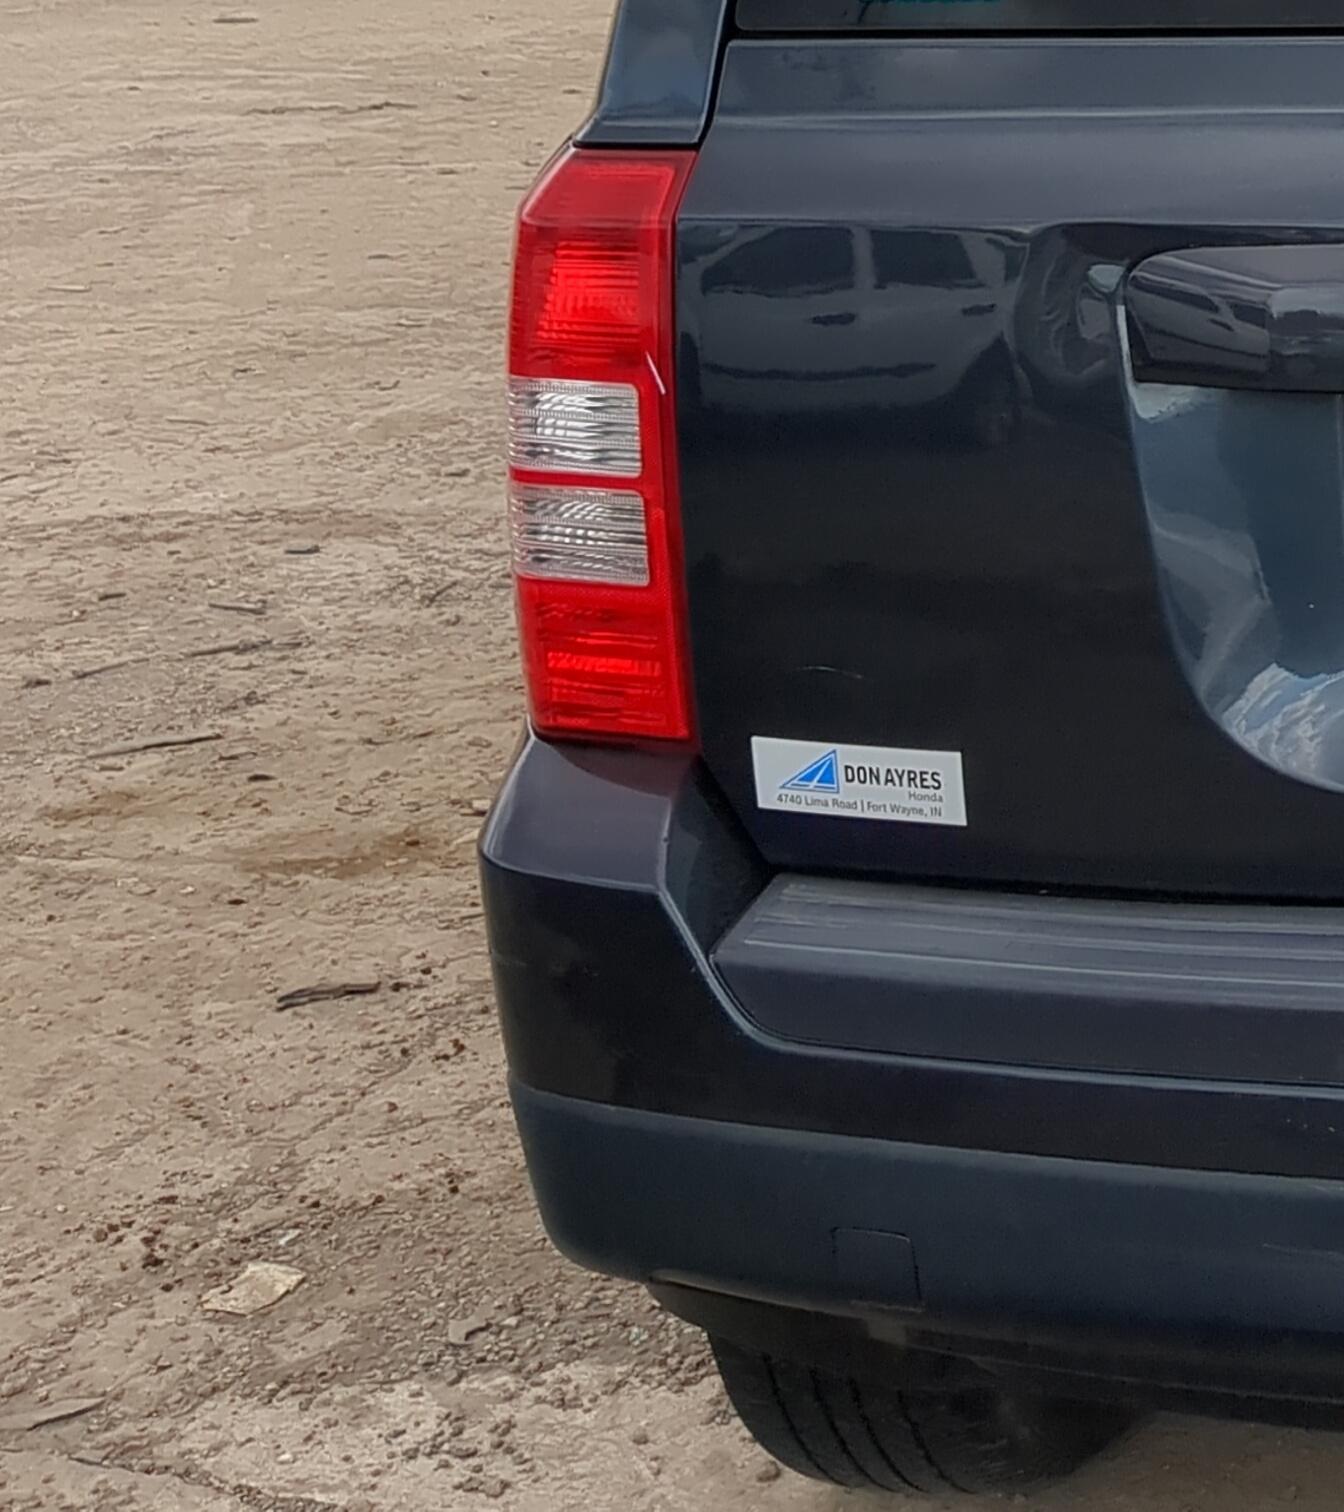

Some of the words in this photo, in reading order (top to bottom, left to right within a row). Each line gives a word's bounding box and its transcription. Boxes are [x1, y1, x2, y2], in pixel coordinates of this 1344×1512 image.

[844, 765, 881, 786] DON
[884, 768, 942, 790] AYRES
[777, 793, 801, 805] 4740
[804, 796, 829, 807] Lima
[831, 798, 857, 810] Road
[867, 801, 887, 812] Fort
[888, 803, 928, 817] Wayne,
[930, 806, 942, 817] IN
[908, 790, 943, 803] Honda
